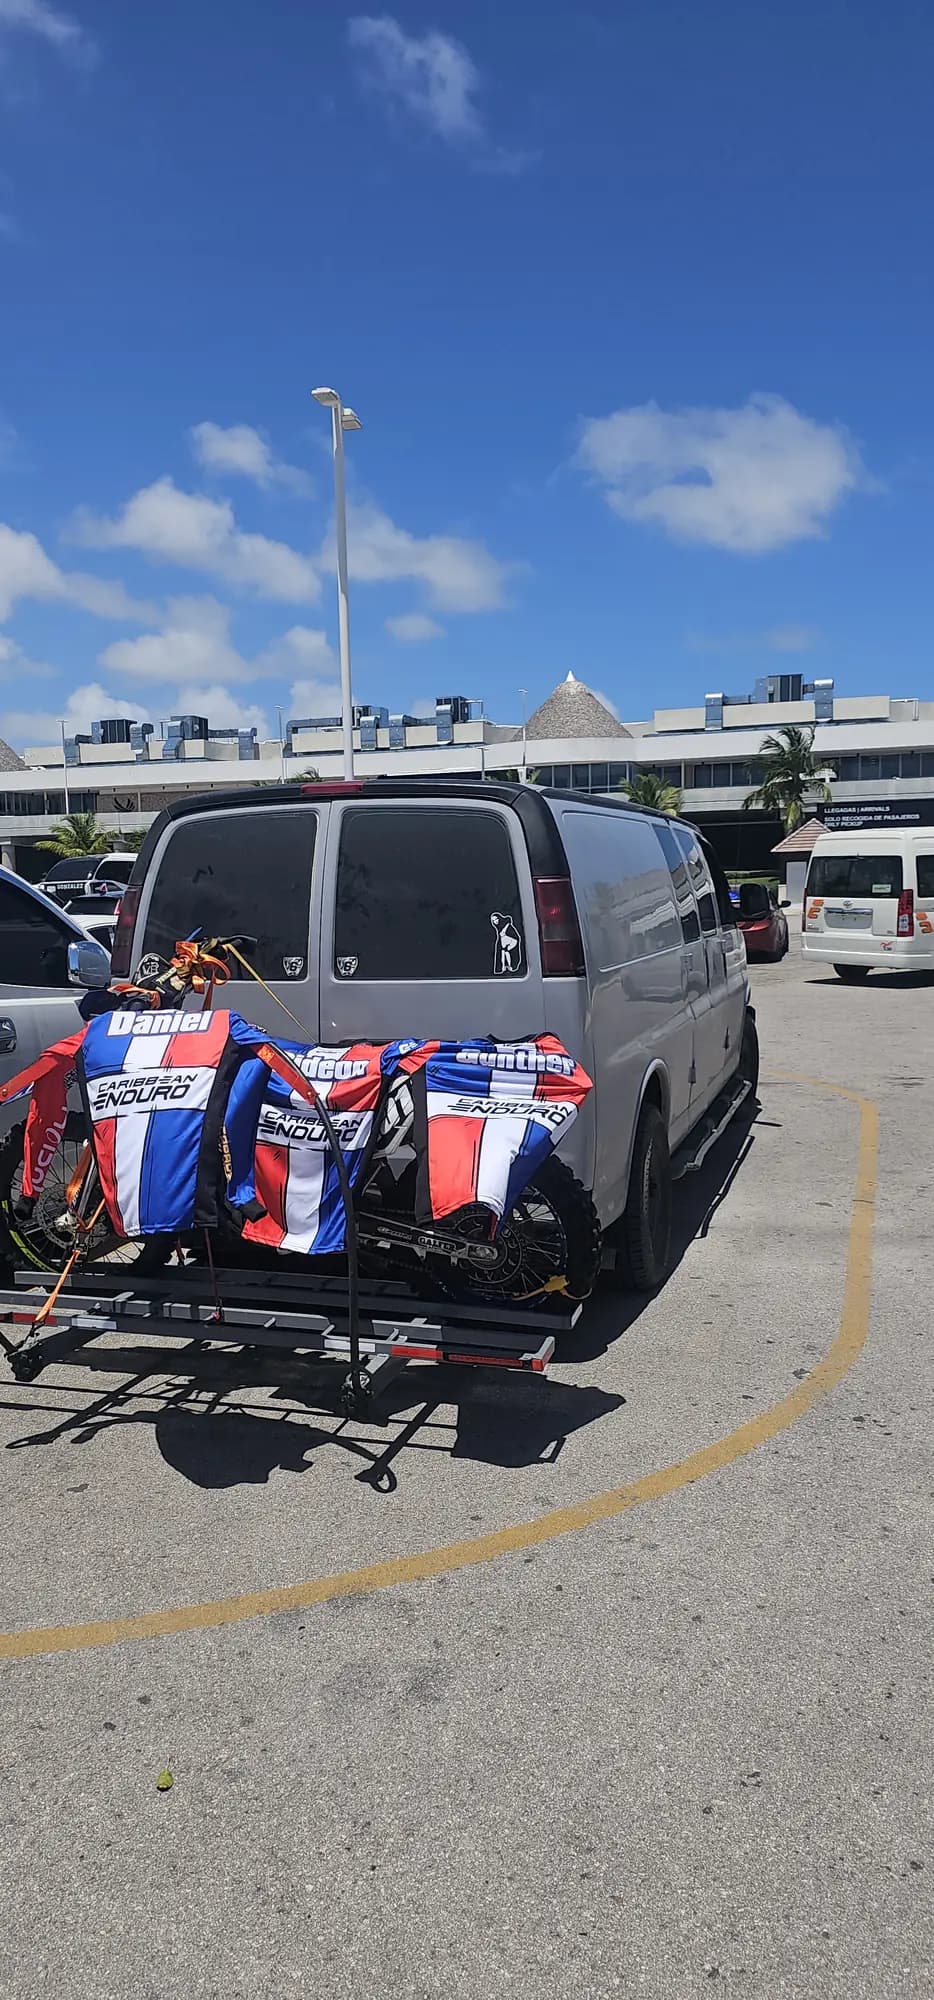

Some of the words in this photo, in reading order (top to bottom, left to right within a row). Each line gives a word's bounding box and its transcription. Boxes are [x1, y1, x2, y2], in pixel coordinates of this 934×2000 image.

[107, 1010, 213, 1036] Daniel
[285, 1051, 370, 1080] ideon
[98, 1074, 198, 1093] CARIBBEAN
[93, 1084, 190, 1110] ENDURO
[458, 1099, 572, 1117] CARIBBEAN
[448, 1103, 566, 1126] ENDURO
